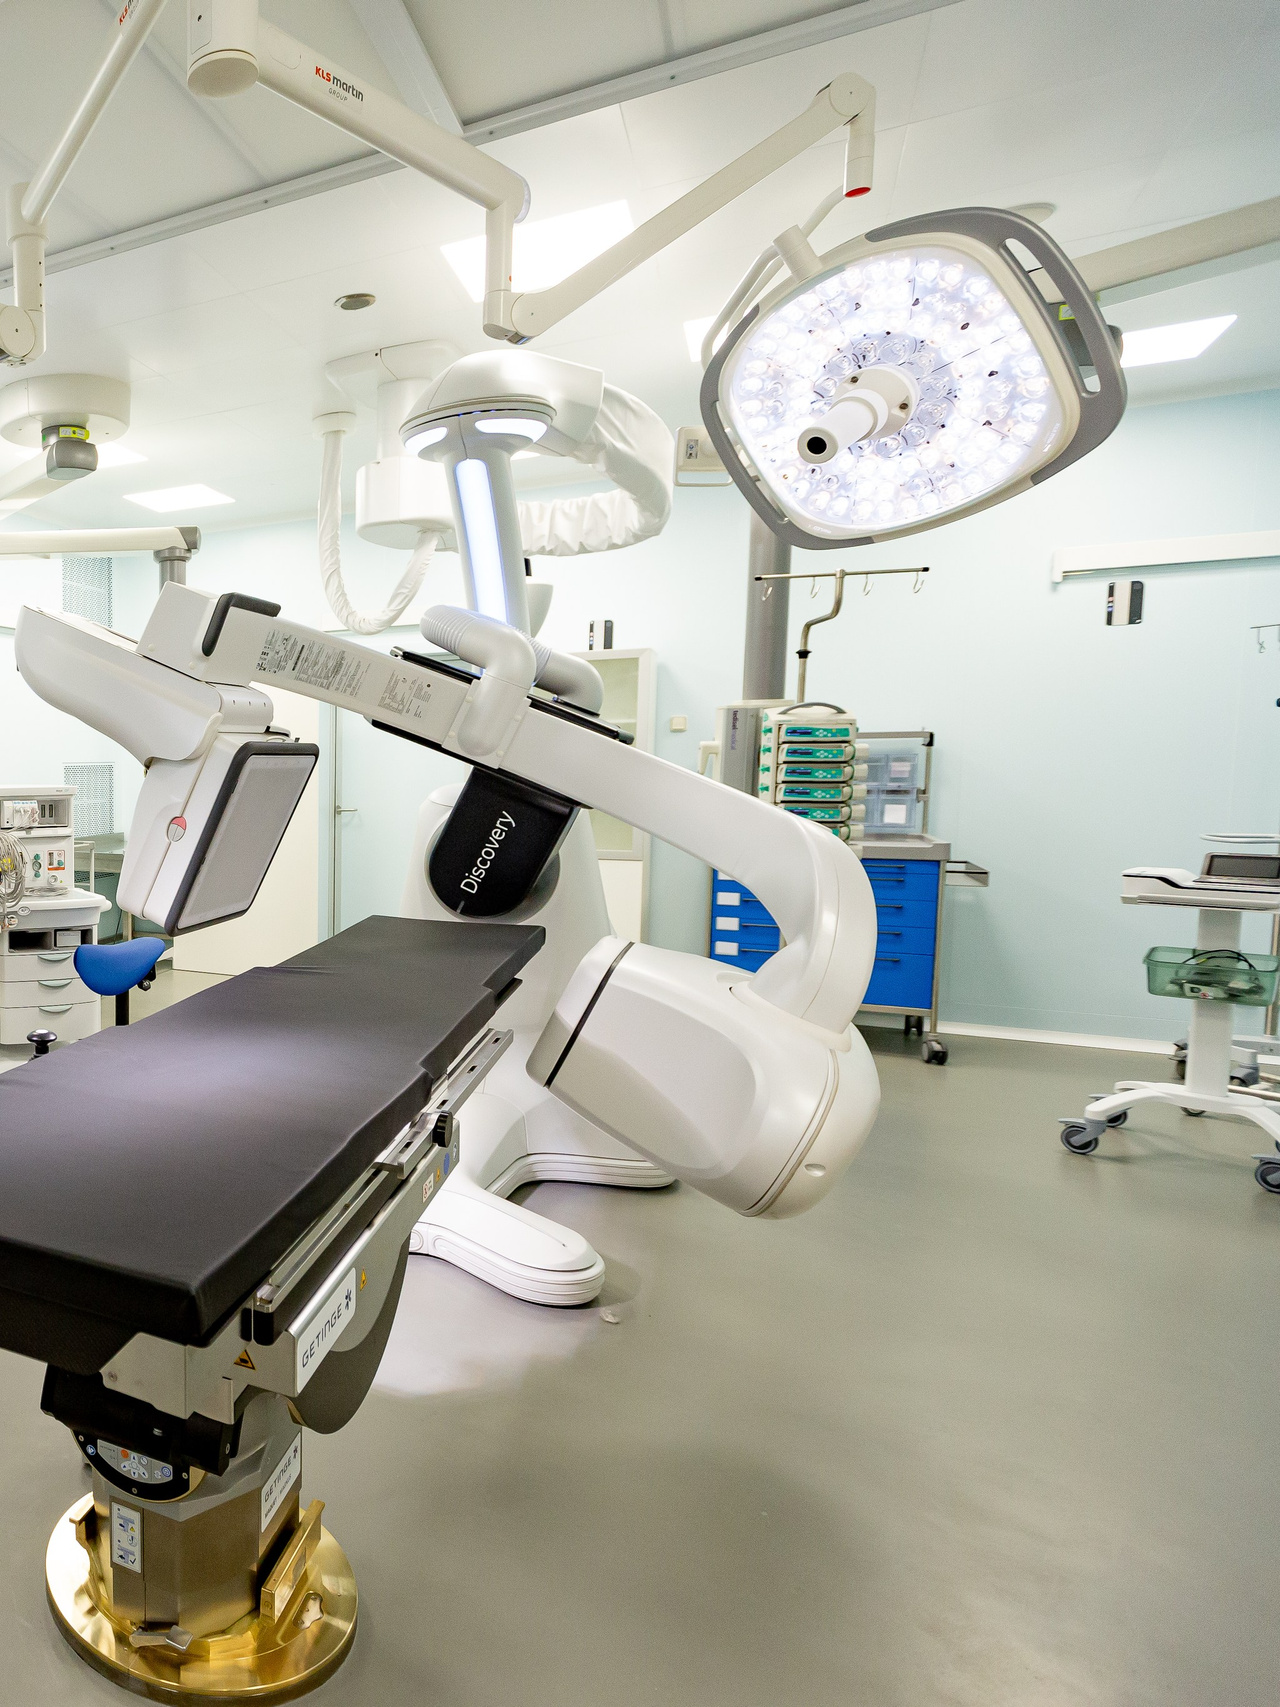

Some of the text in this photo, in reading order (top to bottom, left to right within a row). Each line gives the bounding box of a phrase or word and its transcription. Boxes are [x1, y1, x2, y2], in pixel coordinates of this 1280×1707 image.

[315, 65, 364, 102] KLS martin
[328, 87, 348, 101] GROUP
[460, 810, 516, 894] Discovery
[302, 1303, 343, 1368] GETINGE
[264, 1456, 292, 1503] GETINGE
